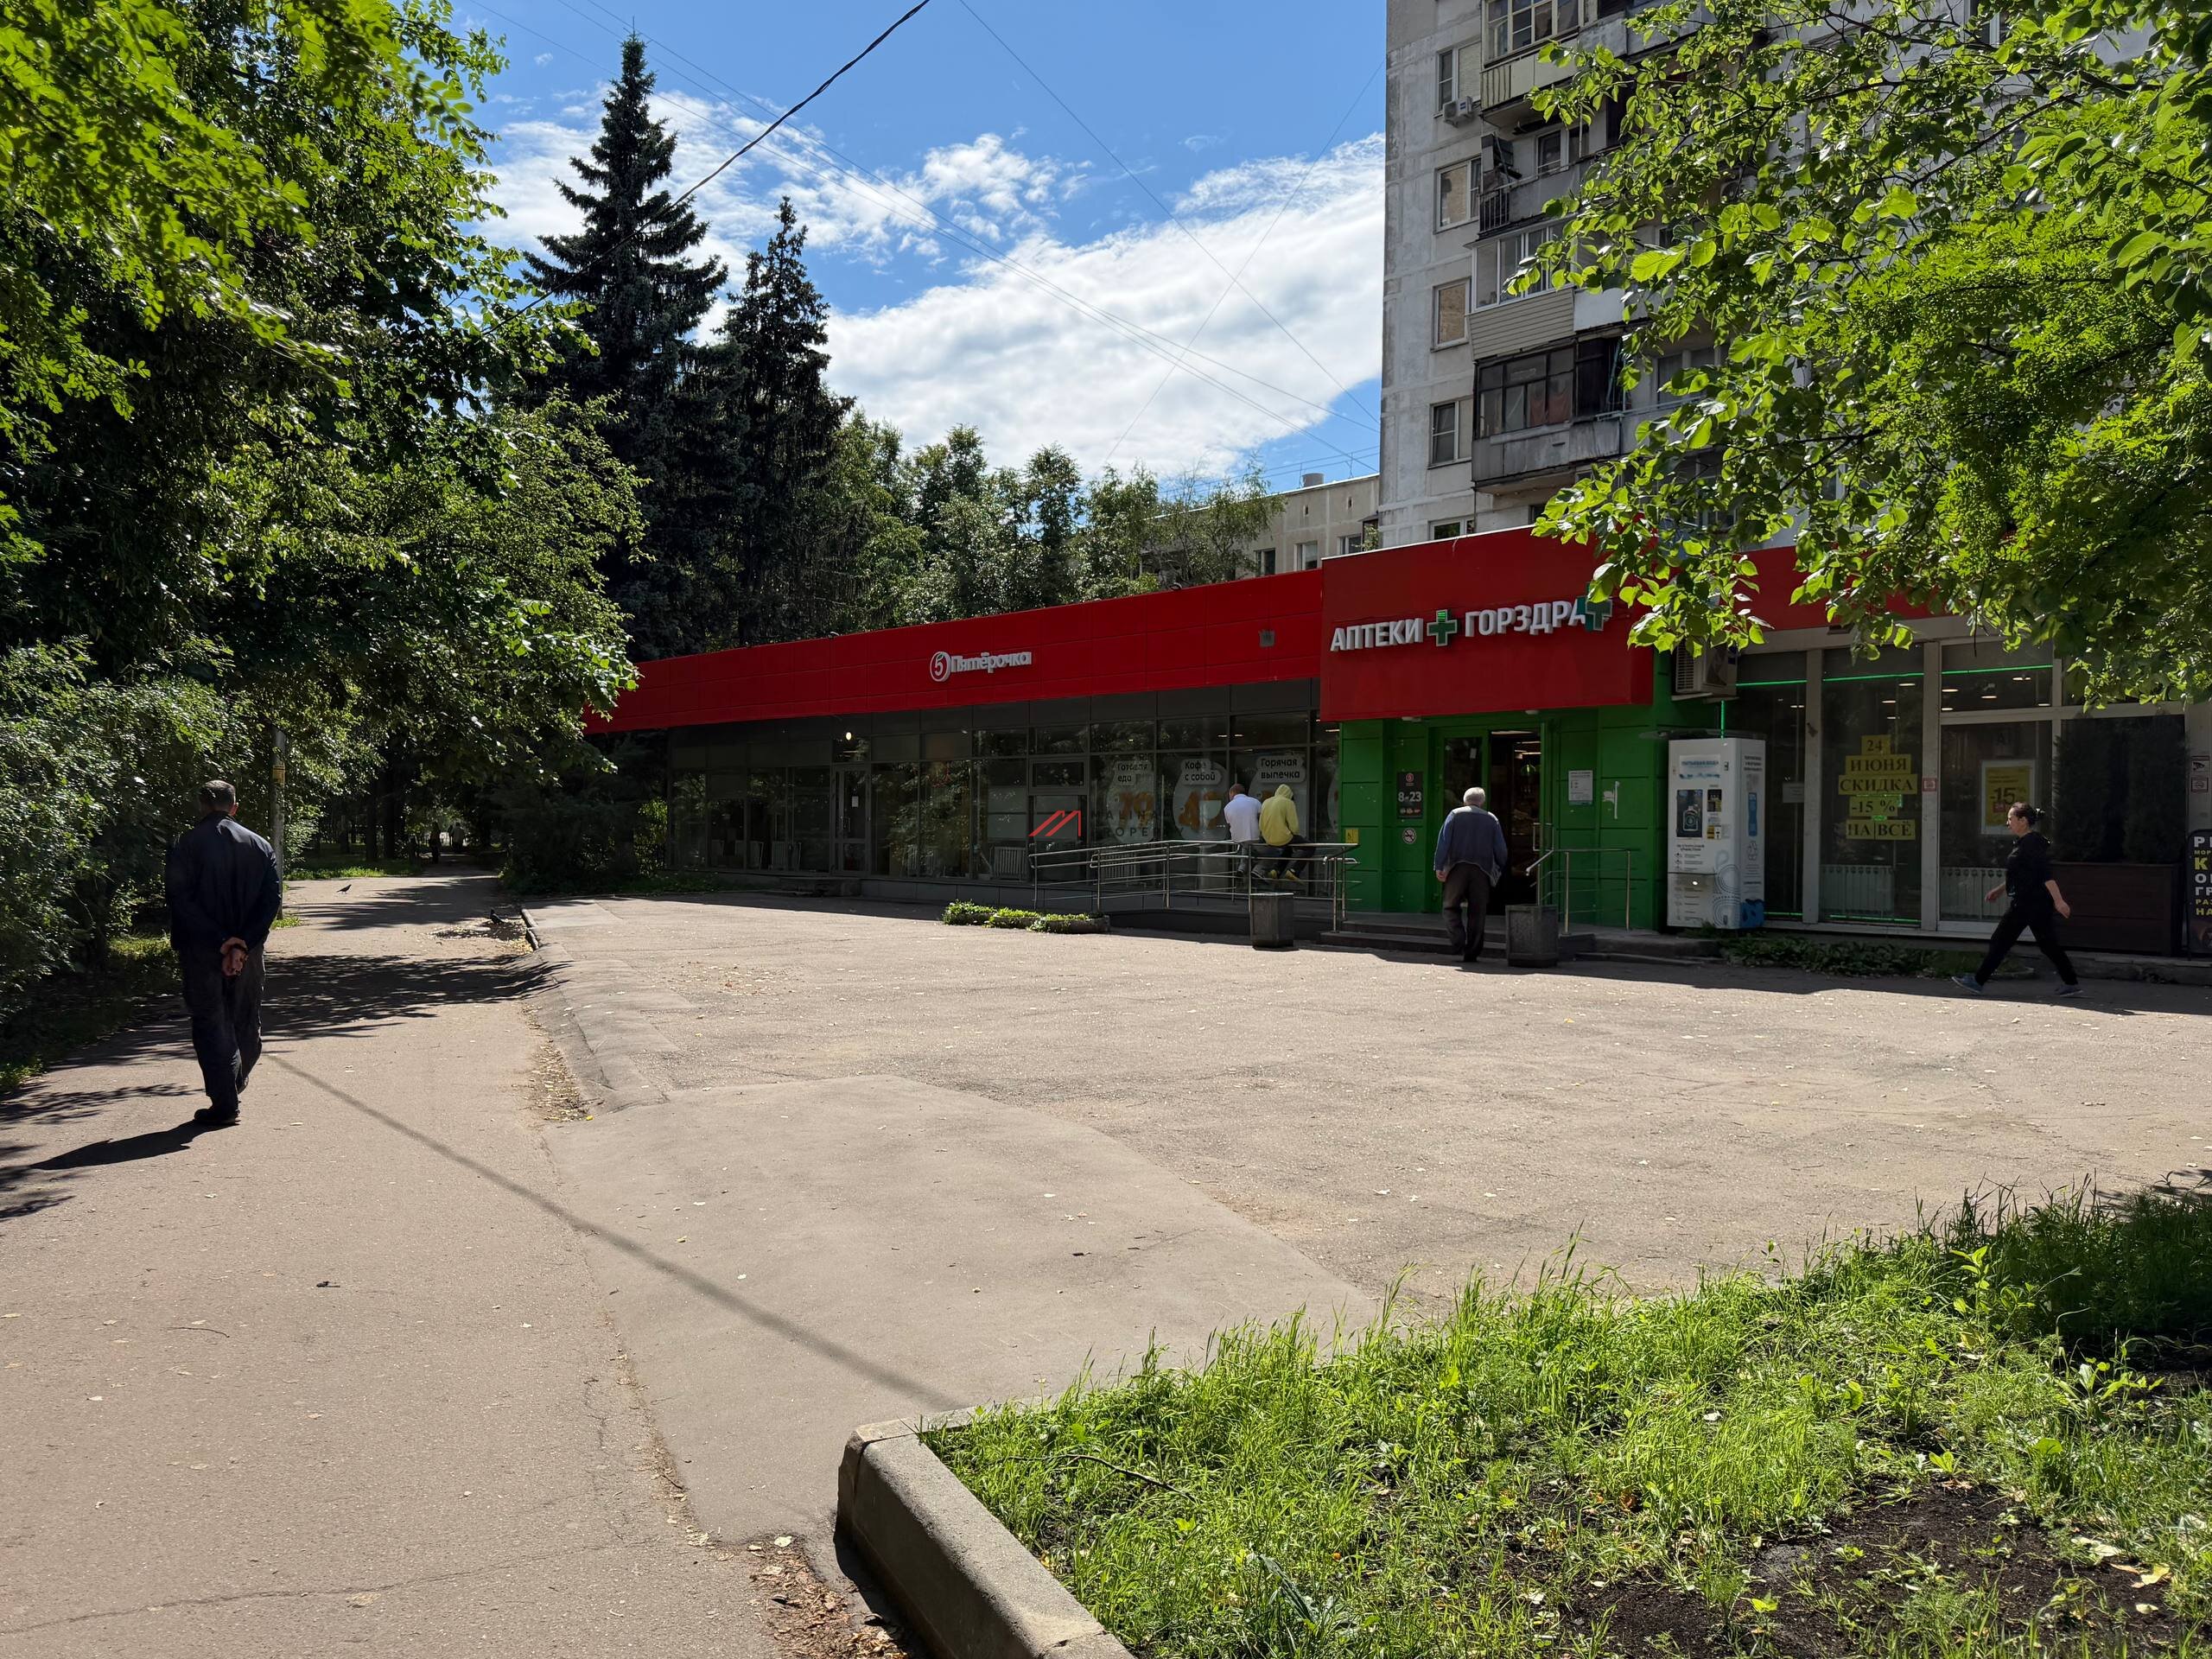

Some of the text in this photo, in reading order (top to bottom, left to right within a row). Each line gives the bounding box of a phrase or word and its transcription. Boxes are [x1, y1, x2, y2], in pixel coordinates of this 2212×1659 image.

[1330, 597, 1608, 652] АПТЕКИ ГОРЗДРА
[951, 652, 1033, 673] Пятёрочка
[1866, 740, 1883, 752] 24
[1261, 759, 1297, 768] Горячая
[1851, 758, 1907, 772] ИЮНЯ
[1191, 772, 1215, 780] собой
[1840, 779, 1913, 792] СКИДКА
[1852, 801, 1873, 813] -15
[1847, 821, 1912, 836] НА ВСЁ
